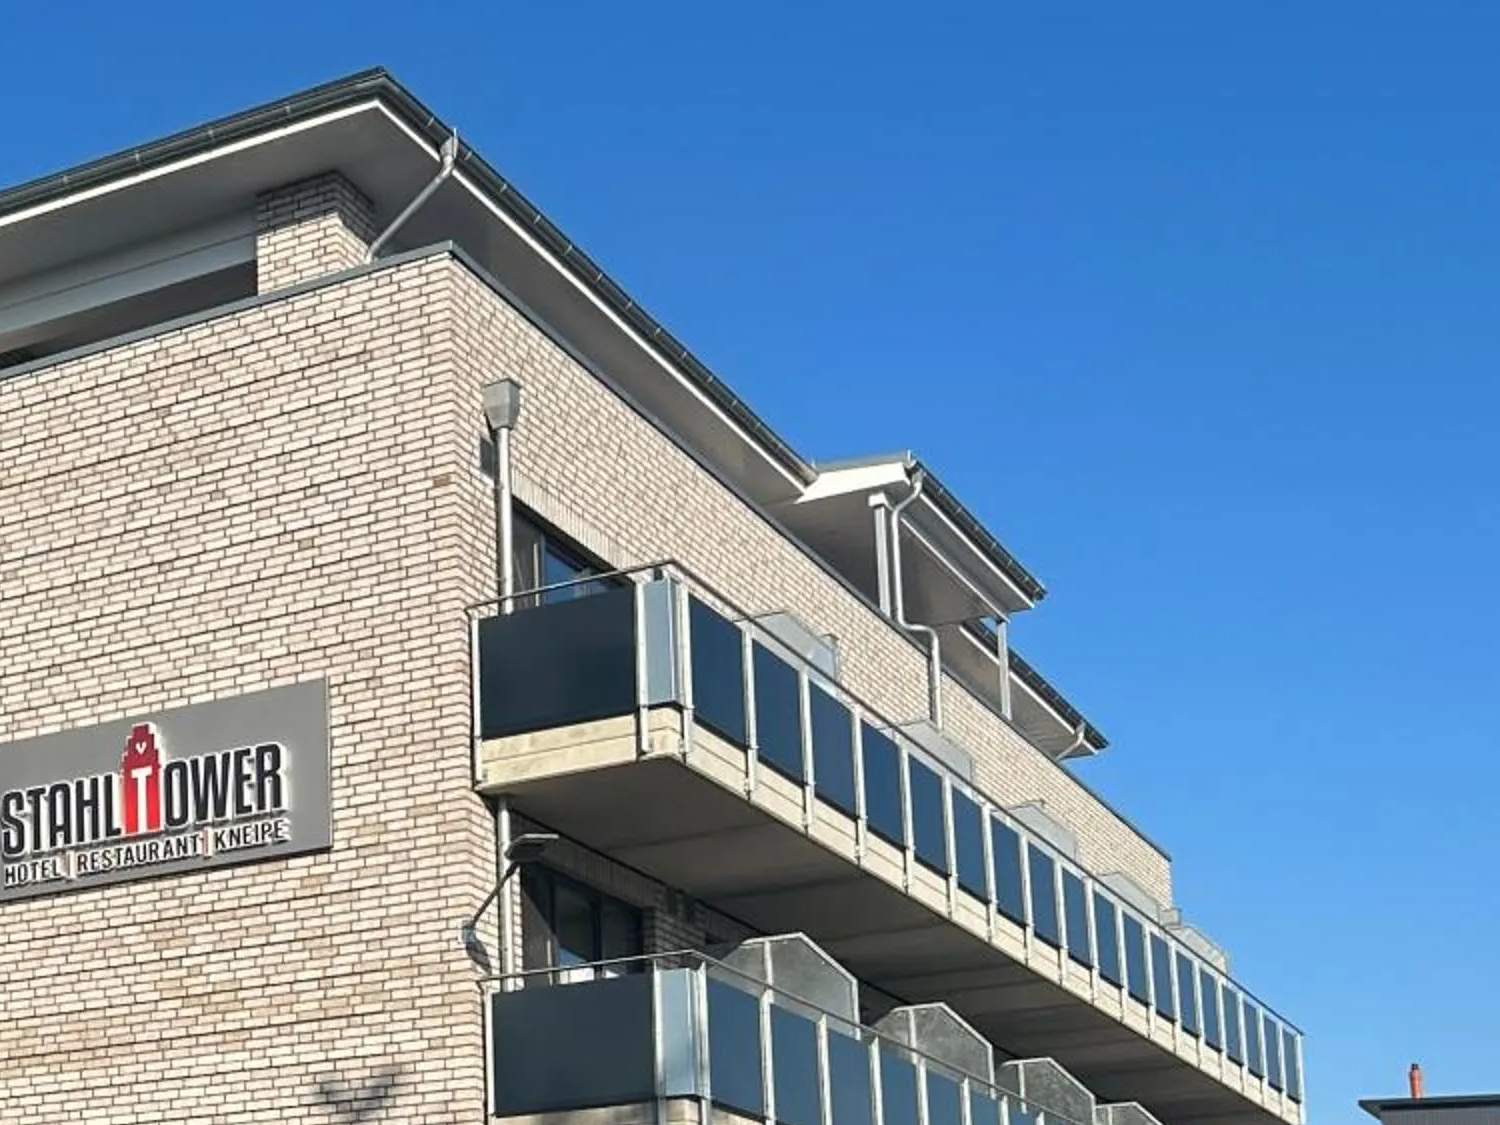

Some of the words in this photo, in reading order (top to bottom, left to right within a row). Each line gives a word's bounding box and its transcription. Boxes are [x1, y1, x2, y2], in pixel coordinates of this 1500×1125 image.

[1, 741, 285, 858] STAHLTOWER
[4, 860, 60, 887] HOTEL
[76, 835, 200, 872] RESTAURANT
[214, 819, 289, 851] KNEIPE
